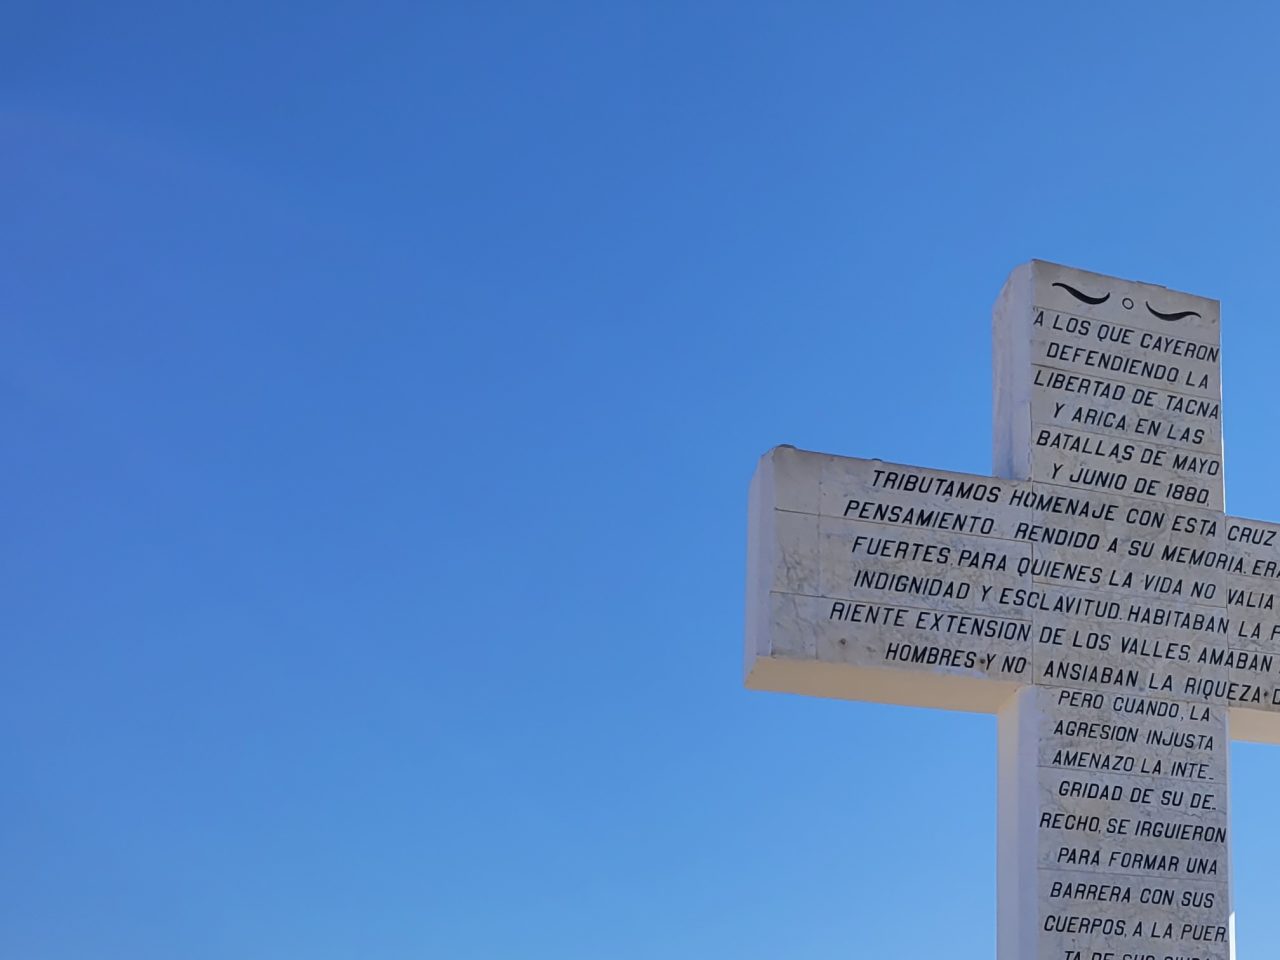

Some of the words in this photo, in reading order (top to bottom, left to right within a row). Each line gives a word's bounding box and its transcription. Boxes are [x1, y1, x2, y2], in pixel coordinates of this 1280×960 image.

[1052, 314, 1090, 336] LOS
[1096, 325, 1135, 345] QUE
[1140, 333, 1219, 363] CAYERON
[1046, 342, 1179, 383] DEFENDIENDO
[1186, 371, 1209, 389] LA
[1033, 370, 1126, 401] LIBERTAD
[1131, 389, 1158, 407] DE
[1166, 395, 1219, 420] TACNA
[1053, 402, 1065, 418] Y
[1135, 418, 1162, 437] EN
[1167, 424, 1205, 445] LAS
[1036, 430, 1135, 461] BATALLAS
[1140, 448, 1167, 466] DE
[1172, 454, 1220, 476] MAYO
[1052, 463, 1064, 480] Y
[1069, 468, 1127, 490] JUNIO
[1133, 478, 1160, 496] DE
[871, 469, 1002, 503] TRIBUTAMOS
[1008, 489, 1119, 521] HOMENAJE
[1126, 508, 1166, 529] CON
[1171, 515, 1217, 538] ESTA
[1227, 525, 1277, 547] CRUZ
[843, 500, 995, 535] PENSAMIENTO
[1014, 522, 1099, 550] RENDIDO
[1106, 537, 1118, 554] A
[1128, 540, 1159, 559] SU
[1161, 545, 1247, 575] MEMORIA.
[957, 549, 1007, 572] PARA
[1016, 557, 1103, 584] QUIENES
[1108, 570, 1133, 589] LA
[1143, 574, 1183, 595] VIDA
[1190, 581, 1216, 600] NO
[1227, 588, 1274, 610] VALIA
[853, 569, 970, 600] INDIGNIDAD
[981, 585, 992, 602] Y
[1127, 603, 1229, 634] HABITABAN
[1238, 621, 1261, 640] LA
[829, 602, 909, 628] RIENTE
[915, 611, 1031, 642] EXTENSION
[1038, 625, 1067, 645] DE
[1072, 629, 1112, 651] LOS
[1197, 647, 1273, 673] AMABAN
[885, 642, 976, 669] HOMBRES
[984, 653, 996, 671] Y
[1001, 655, 1028, 674] NO
[1043, 662, 1140, 688] ANSIABAN
[1148, 672, 1173, 692] LA
[1184, 677, 1261, 703] RIQUEZA
[1057, 690, 1105, 709] PERO
[1189, 705, 1210, 722] LA
[1053, 719, 1139, 743] AGRESION
[1146, 729, 1214, 751] INJUSTA
[1052, 750, 1135, 772] AMENAZO
[1140, 758, 1162, 775] LA
[1058, 780, 1123, 801] GRIDAD
[1129, 788, 1155, 804] DE
[1160, 790, 1184, 807] SU
[1106, 818, 1131, 835] SE
[1134, 820, 1227, 843] IRGUIERON
[1056, 847, 1100, 867] PARA
[1108, 851, 1179, 872] FORMAR
[1186, 857, 1218, 875] UNA
[1049, 881, 1131, 904] BARRERA
[1139, 888, 1175, 906] CON
[1181, 891, 1215, 909] SUS
[1132, 921, 1143, 938] A
[1150, 921, 1173, 940] LA
